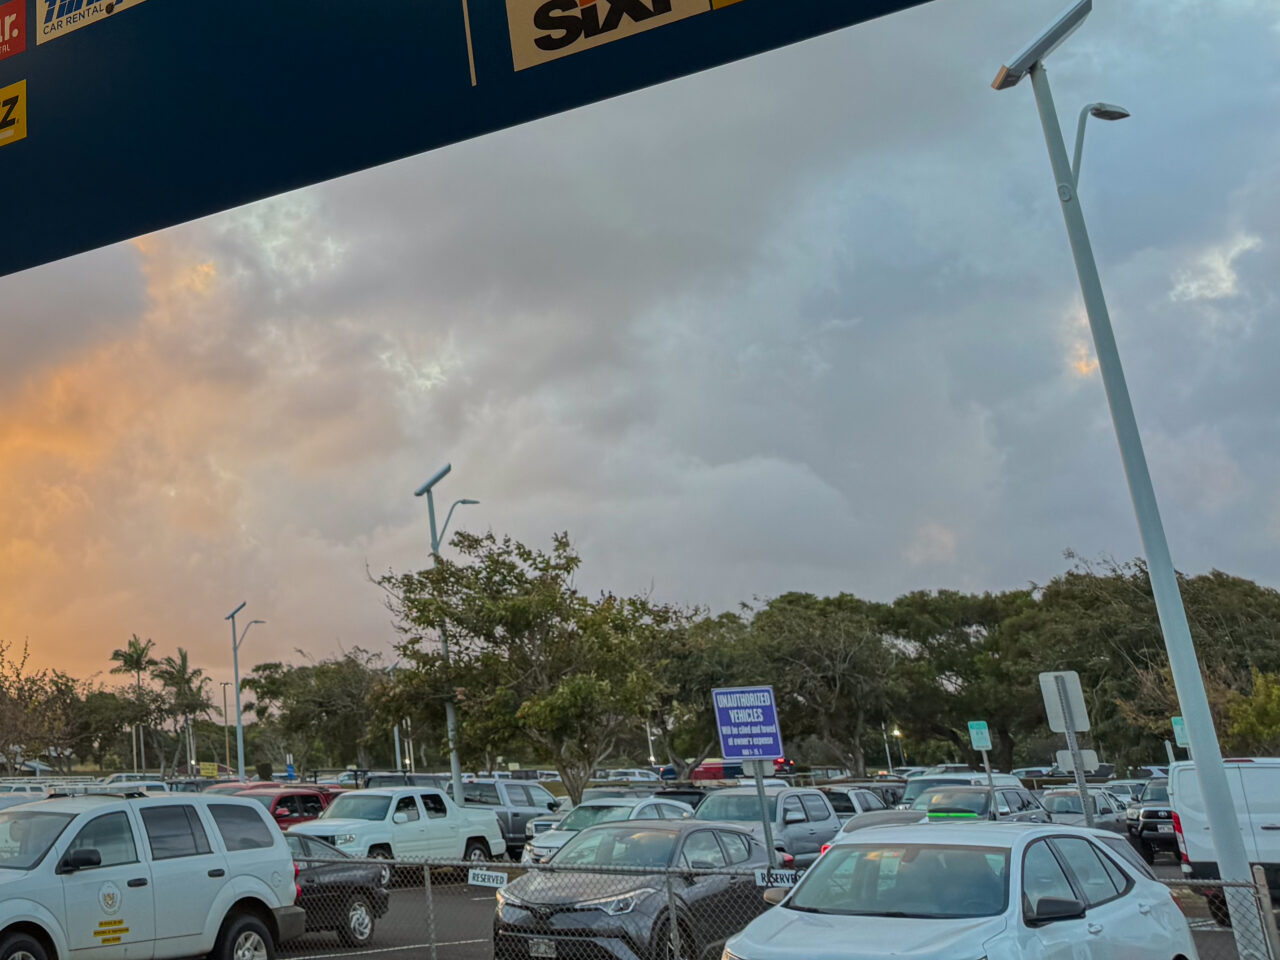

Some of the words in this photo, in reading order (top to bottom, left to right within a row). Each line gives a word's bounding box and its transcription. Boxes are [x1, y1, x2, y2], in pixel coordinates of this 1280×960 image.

[43, 21, 64, 35] CAR
[65, 5, 104, 28] RENTAL
[716, 692, 771, 708] UNAUTHORIZED
[728, 709, 764, 723] VEHICLES
[472, 872, 505, 885] RESERVED
